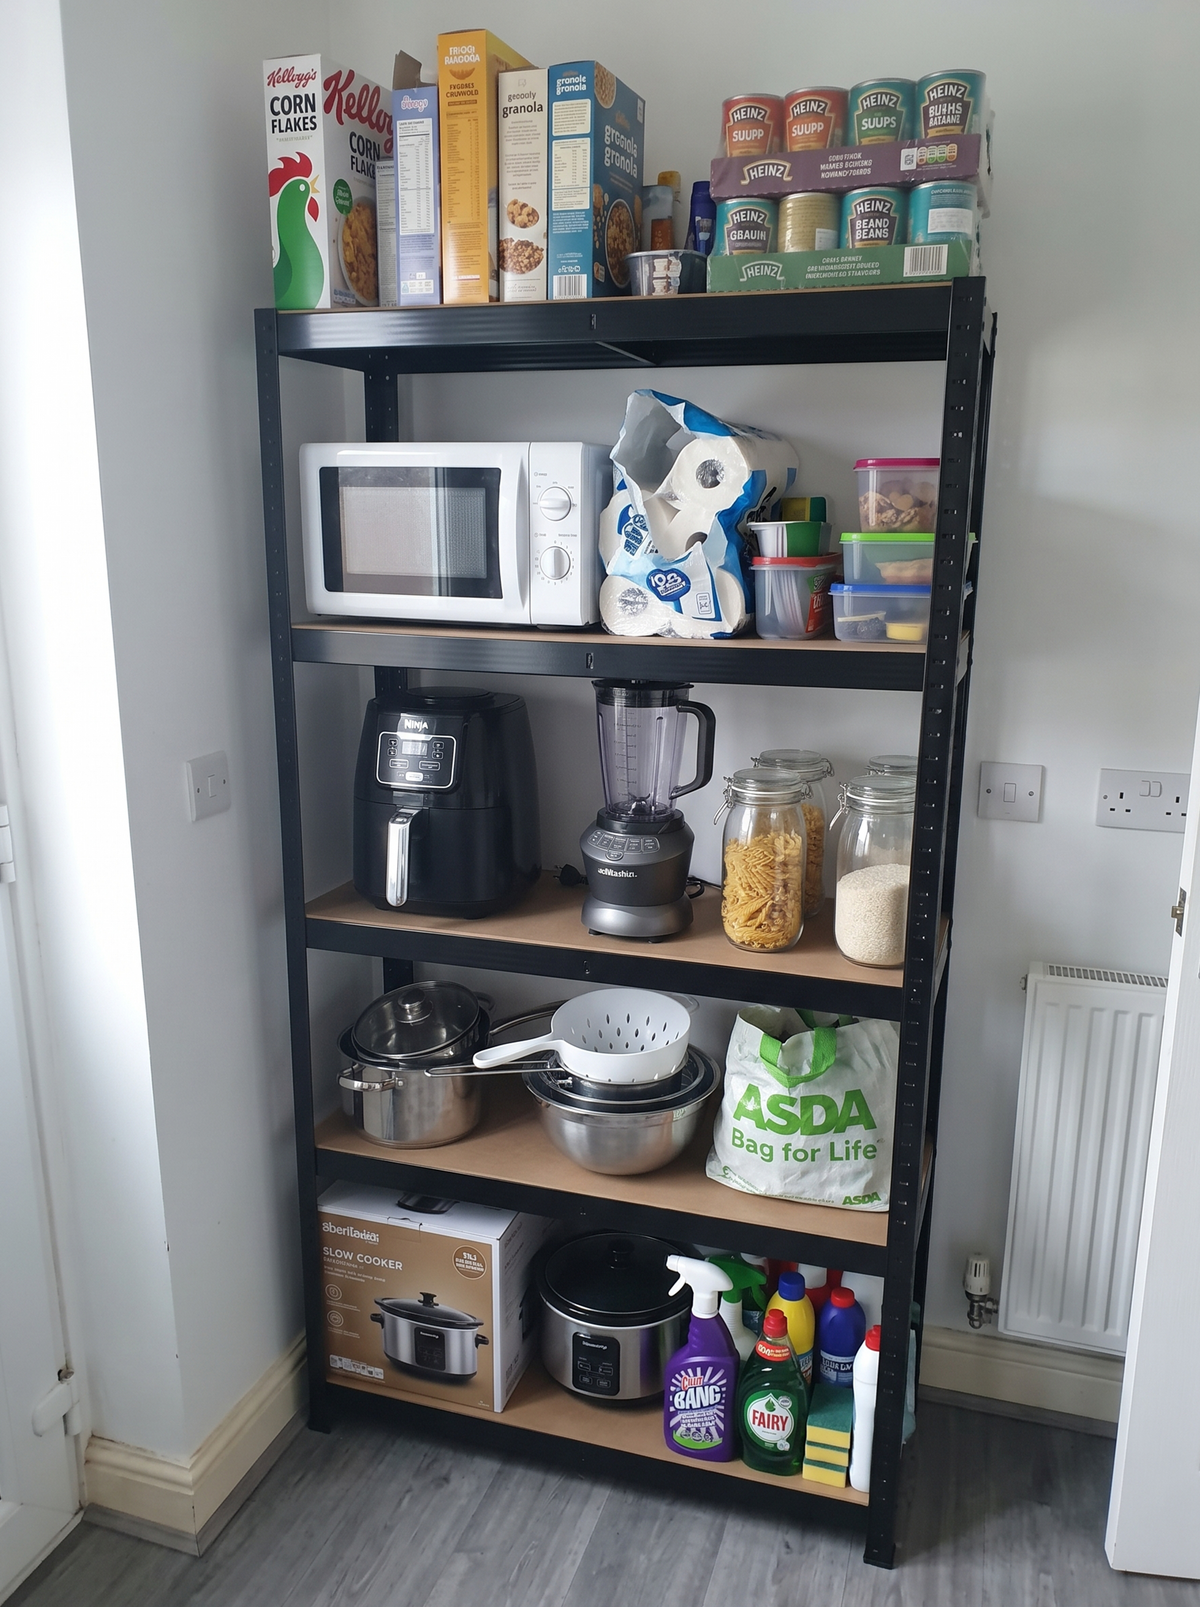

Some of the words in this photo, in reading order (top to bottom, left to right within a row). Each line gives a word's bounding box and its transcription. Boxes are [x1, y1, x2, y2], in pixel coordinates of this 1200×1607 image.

[929, 85, 966, 101] HEINZ
[270, 93, 316, 116] CORN
[502, 101, 544, 119] granola
[793, 101, 826, 117] HEINZ
[862, 94, 898, 110] HEINZ
[733, 107, 766, 123] HEINZ
[271, 115, 318, 135] FLAKES
[792, 122, 825, 137] SUUPP
[861, 116, 897, 131] SUUPS
[732, 129, 764, 142] SUUPP
[349, 131, 381, 161] CORN
[749, 165, 785, 180] HEINZ
[856, 200, 891, 214] HEINZ
[732, 210, 765, 224] HEINZ
[855, 218, 889, 230] BEAND
[855, 228, 889, 240] BEANS
[746, 264, 778, 279] HEINZ
[733, 1083, 878, 1136] ASDA
[731, 1127, 774, 1163] Bag
[782, 1142, 821, 1162] for
[829, 1139, 878, 1162] Life
[842, 1191, 882, 1206] ASDA
[323, 1246, 354, 1260] SLOW
[357, 1253, 403, 1271] COOKER
[674, 1385, 721, 1410] BANG
[752, 1409, 789, 1432] FAIRY
